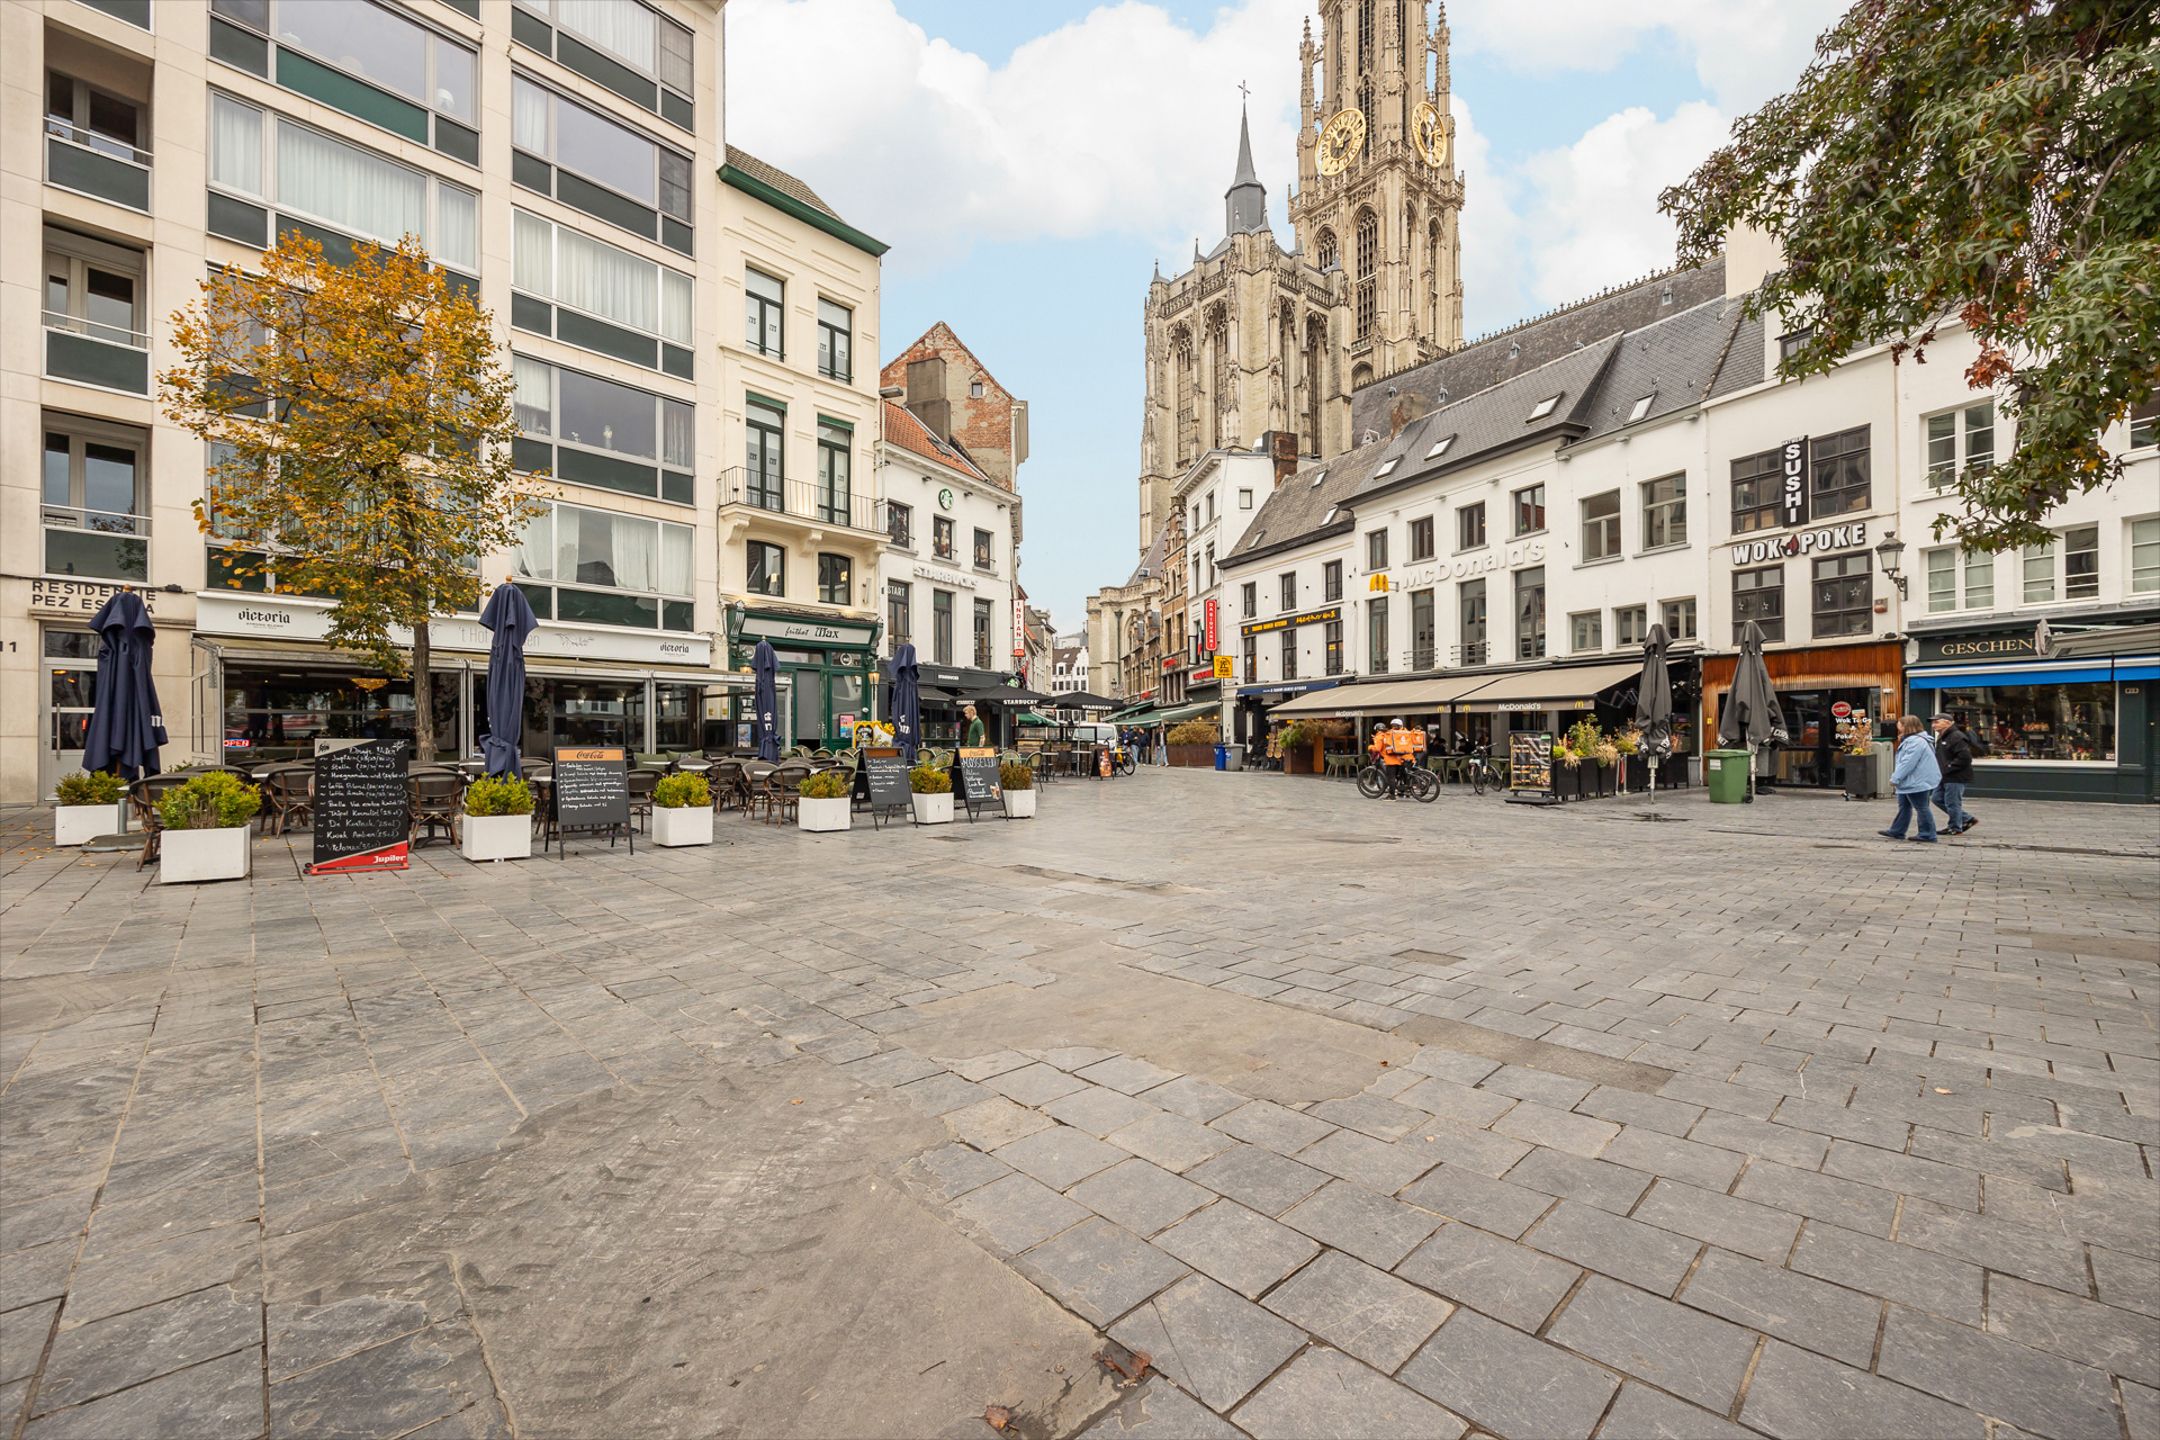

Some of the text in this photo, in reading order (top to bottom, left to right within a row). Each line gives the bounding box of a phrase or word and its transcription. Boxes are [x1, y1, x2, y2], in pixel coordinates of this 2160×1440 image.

[1785, 443, 1802, 523] SUSHI
[1732, 523, 1866, 565] WOK POKE
[1403, 542, 1546, 589] McDonald's
[32, 581, 156, 600] RESIDENIE
[887, 585, 905, 596] START
[32, 594, 70, 607] PEZ
[974, 603, 988, 613] OFFEE
[238, 608, 290, 623] victoria
[660, 641, 689, 653] victoria
[1941, 638, 2034, 655] GESCHEN
[1498, 702, 1541, 711] McDonald's
[223, 739, 250, 747] OPEN
[373, 855, 407, 863] Jupiler
